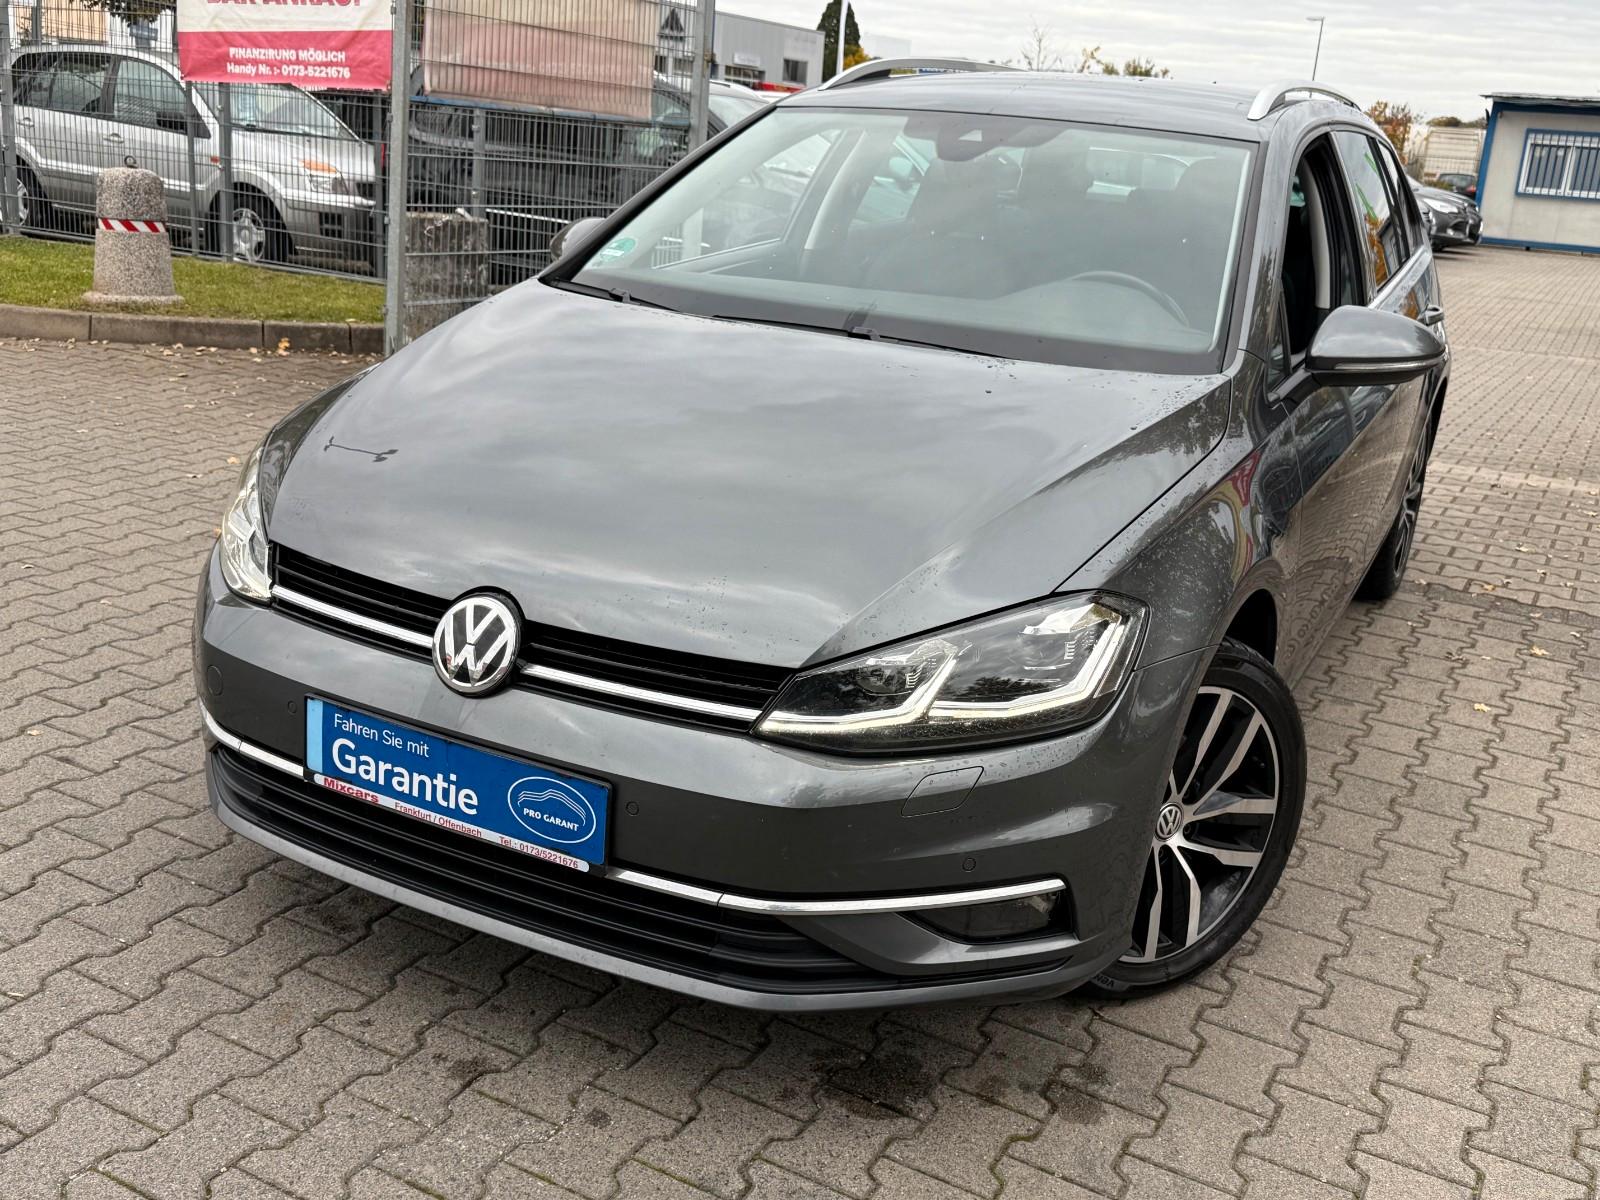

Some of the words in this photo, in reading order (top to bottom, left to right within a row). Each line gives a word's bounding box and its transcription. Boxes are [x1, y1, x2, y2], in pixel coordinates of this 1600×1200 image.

[226, 62, 256, 76] Handy
[258, 63, 272, 75] Nr.
[281, 64, 351, 78] 0173-5221676
[229, 47, 297, 60] FINANZIRUNG
[299, 48, 346, 62] MÖGLICH
[334, 713, 378, 742] Fahren
[382, 729, 403, 749] Sie
[407, 740, 430, 758] mit
[332, 737, 478, 815] Garantie
[323, 777, 379, 804] Mixcars
[394, 802, 432, 822] Frankfurt
[438, 816, 482, 838] Offenbach
[519, 842, 579, 869] 0173/5221676
[523, 807, 541, 820] PRO
[543, 813, 579, 832] GARANT
